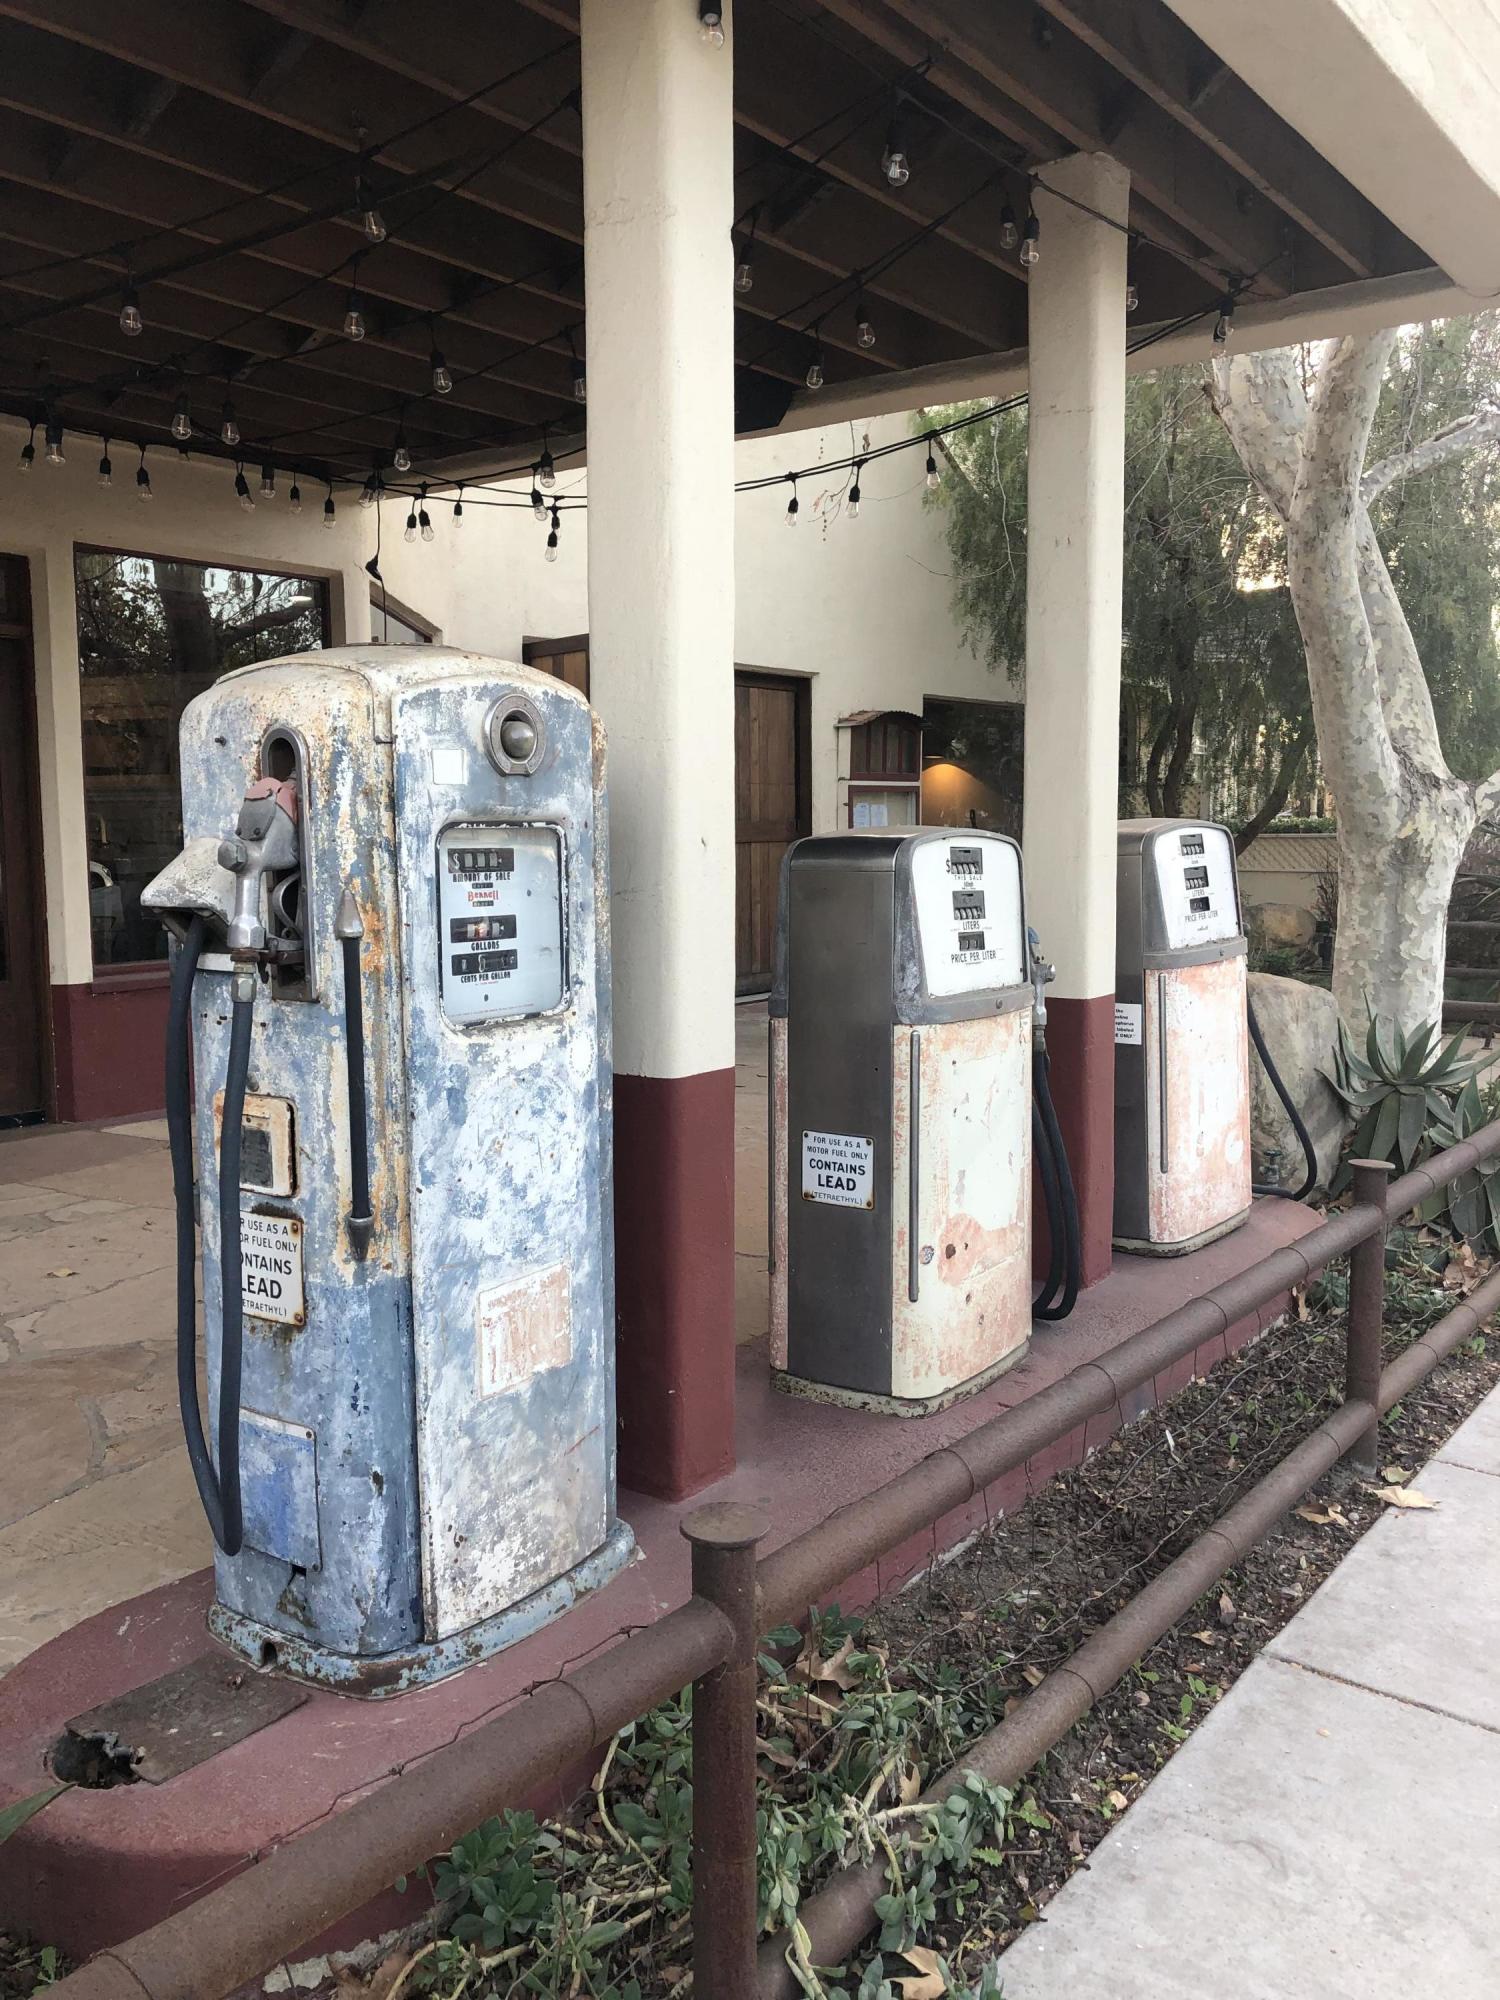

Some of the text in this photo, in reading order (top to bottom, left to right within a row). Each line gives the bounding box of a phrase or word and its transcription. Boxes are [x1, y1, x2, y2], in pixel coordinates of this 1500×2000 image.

[452, 872, 511, 882] AMOUNT OF SALE
[962, 920, 980, 931] LITERS
[471, 941, 500, 951] GALLONS
[950, 953, 968, 963] PRICE
[970, 952, 980, 961] PER
[982, 950, 996, 960] LITER
[460, 974, 478, 983] CENTS
[479, 973, 489, 981] PER
[813, 1136, 826, 1144] FOR
[829, 1138, 841, 1146] USE
[807, 1146, 868, 1160] MOTOR FUEL ONLY
[809, 1158, 866, 1175] CONTAINS
[818, 1173, 857, 1191] LEAD
[247, 1219, 263, 1232] USE
[266, 1223, 279, 1234] AS
[282, 1225, 289, 1236] A
[252, 1235, 273, 1249] FUEL
[275, 1240, 298, 1253] ONLY
[240, 1251, 292, 1275] NTAINS
